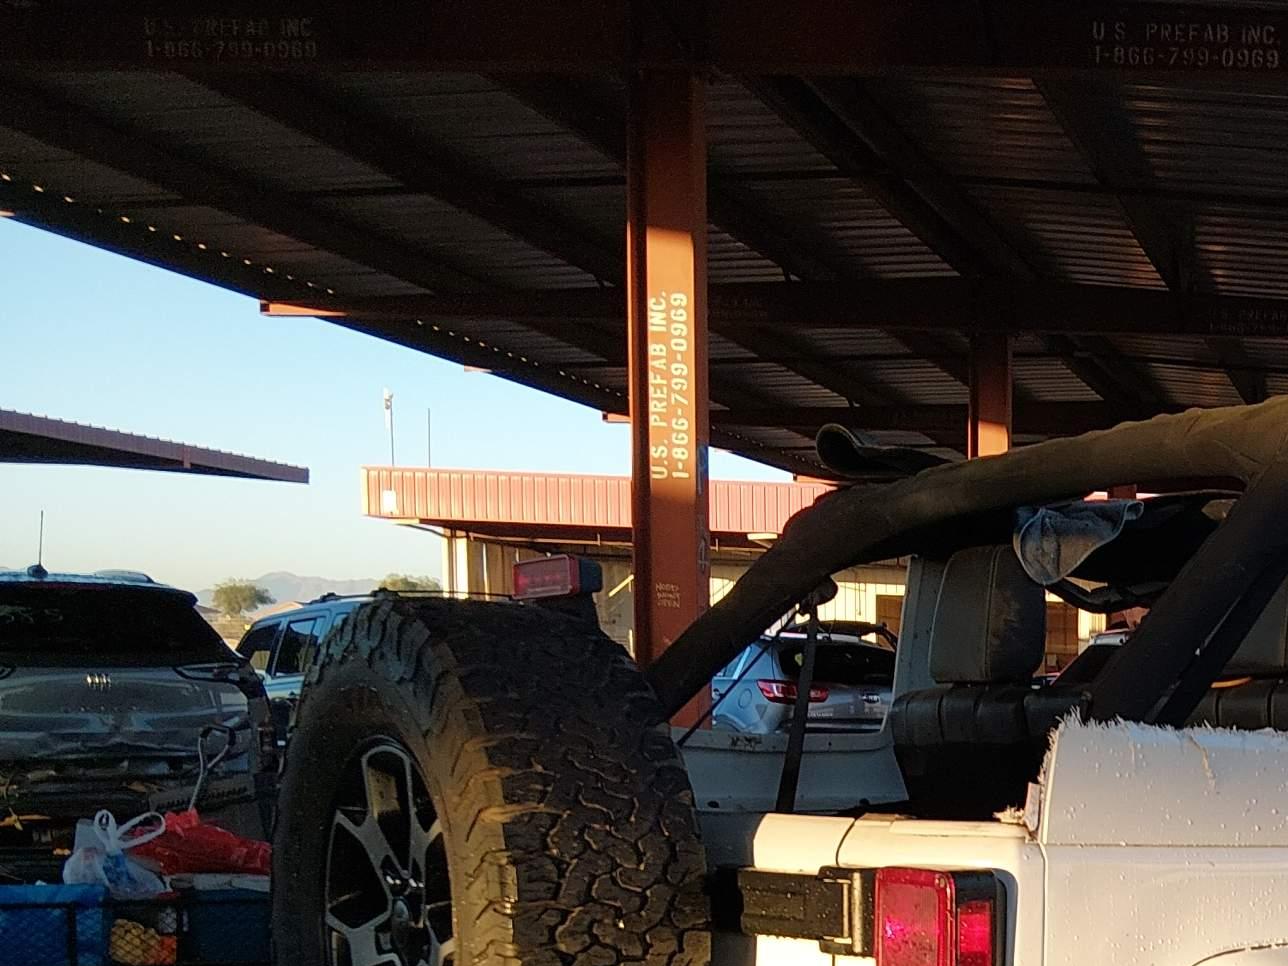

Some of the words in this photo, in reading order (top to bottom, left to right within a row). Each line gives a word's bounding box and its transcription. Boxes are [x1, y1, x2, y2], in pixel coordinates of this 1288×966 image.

[1145, 23, 1230, 44] PREFAB
[1094, 45, 1280, 69] 1-866-799-0969
[649, 290, 667, 333] INC.
[650, 343, 668, 427] PREFAB
[669, 292, 690, 480] 1-866-799-0969
[650, 439, 668, 480] U.S.
